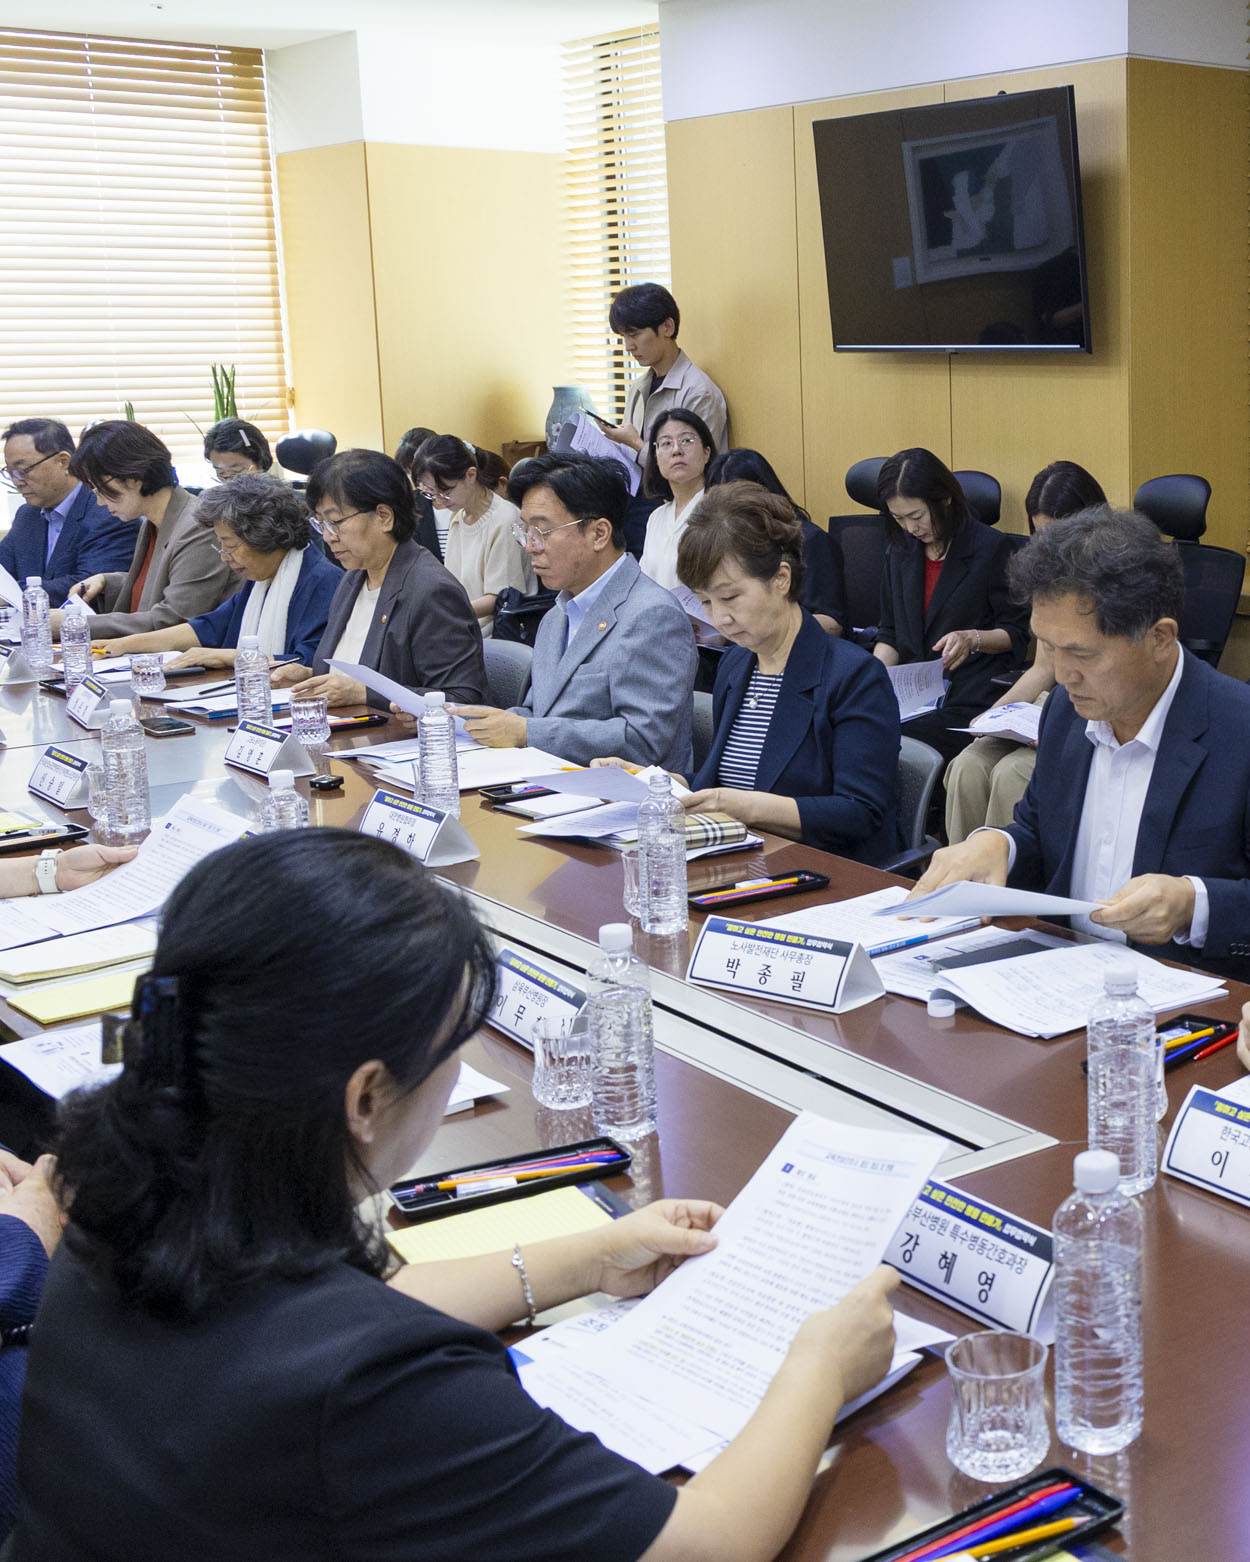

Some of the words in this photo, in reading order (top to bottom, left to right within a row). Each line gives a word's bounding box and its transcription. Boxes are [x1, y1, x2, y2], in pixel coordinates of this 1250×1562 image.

[730, 940, 779, 959] 노사발전재단
[780, 949, 814, 966] 사무총장
[726, 958, 742, 980] 박
[757, 963, 772, 986] 종
[790, 970, 806, 993] 필
[1211, 1150, 1230, 1179] 이
[907, 1206, 950, 1237] 부산병원
[950, 1223, 1029, 1276] 특수병동간호과장
[900, 1231, 921, 1264] 강
[938, 1250, 959, 1285] 혜
[978, 1271, 997, 1304] 영
